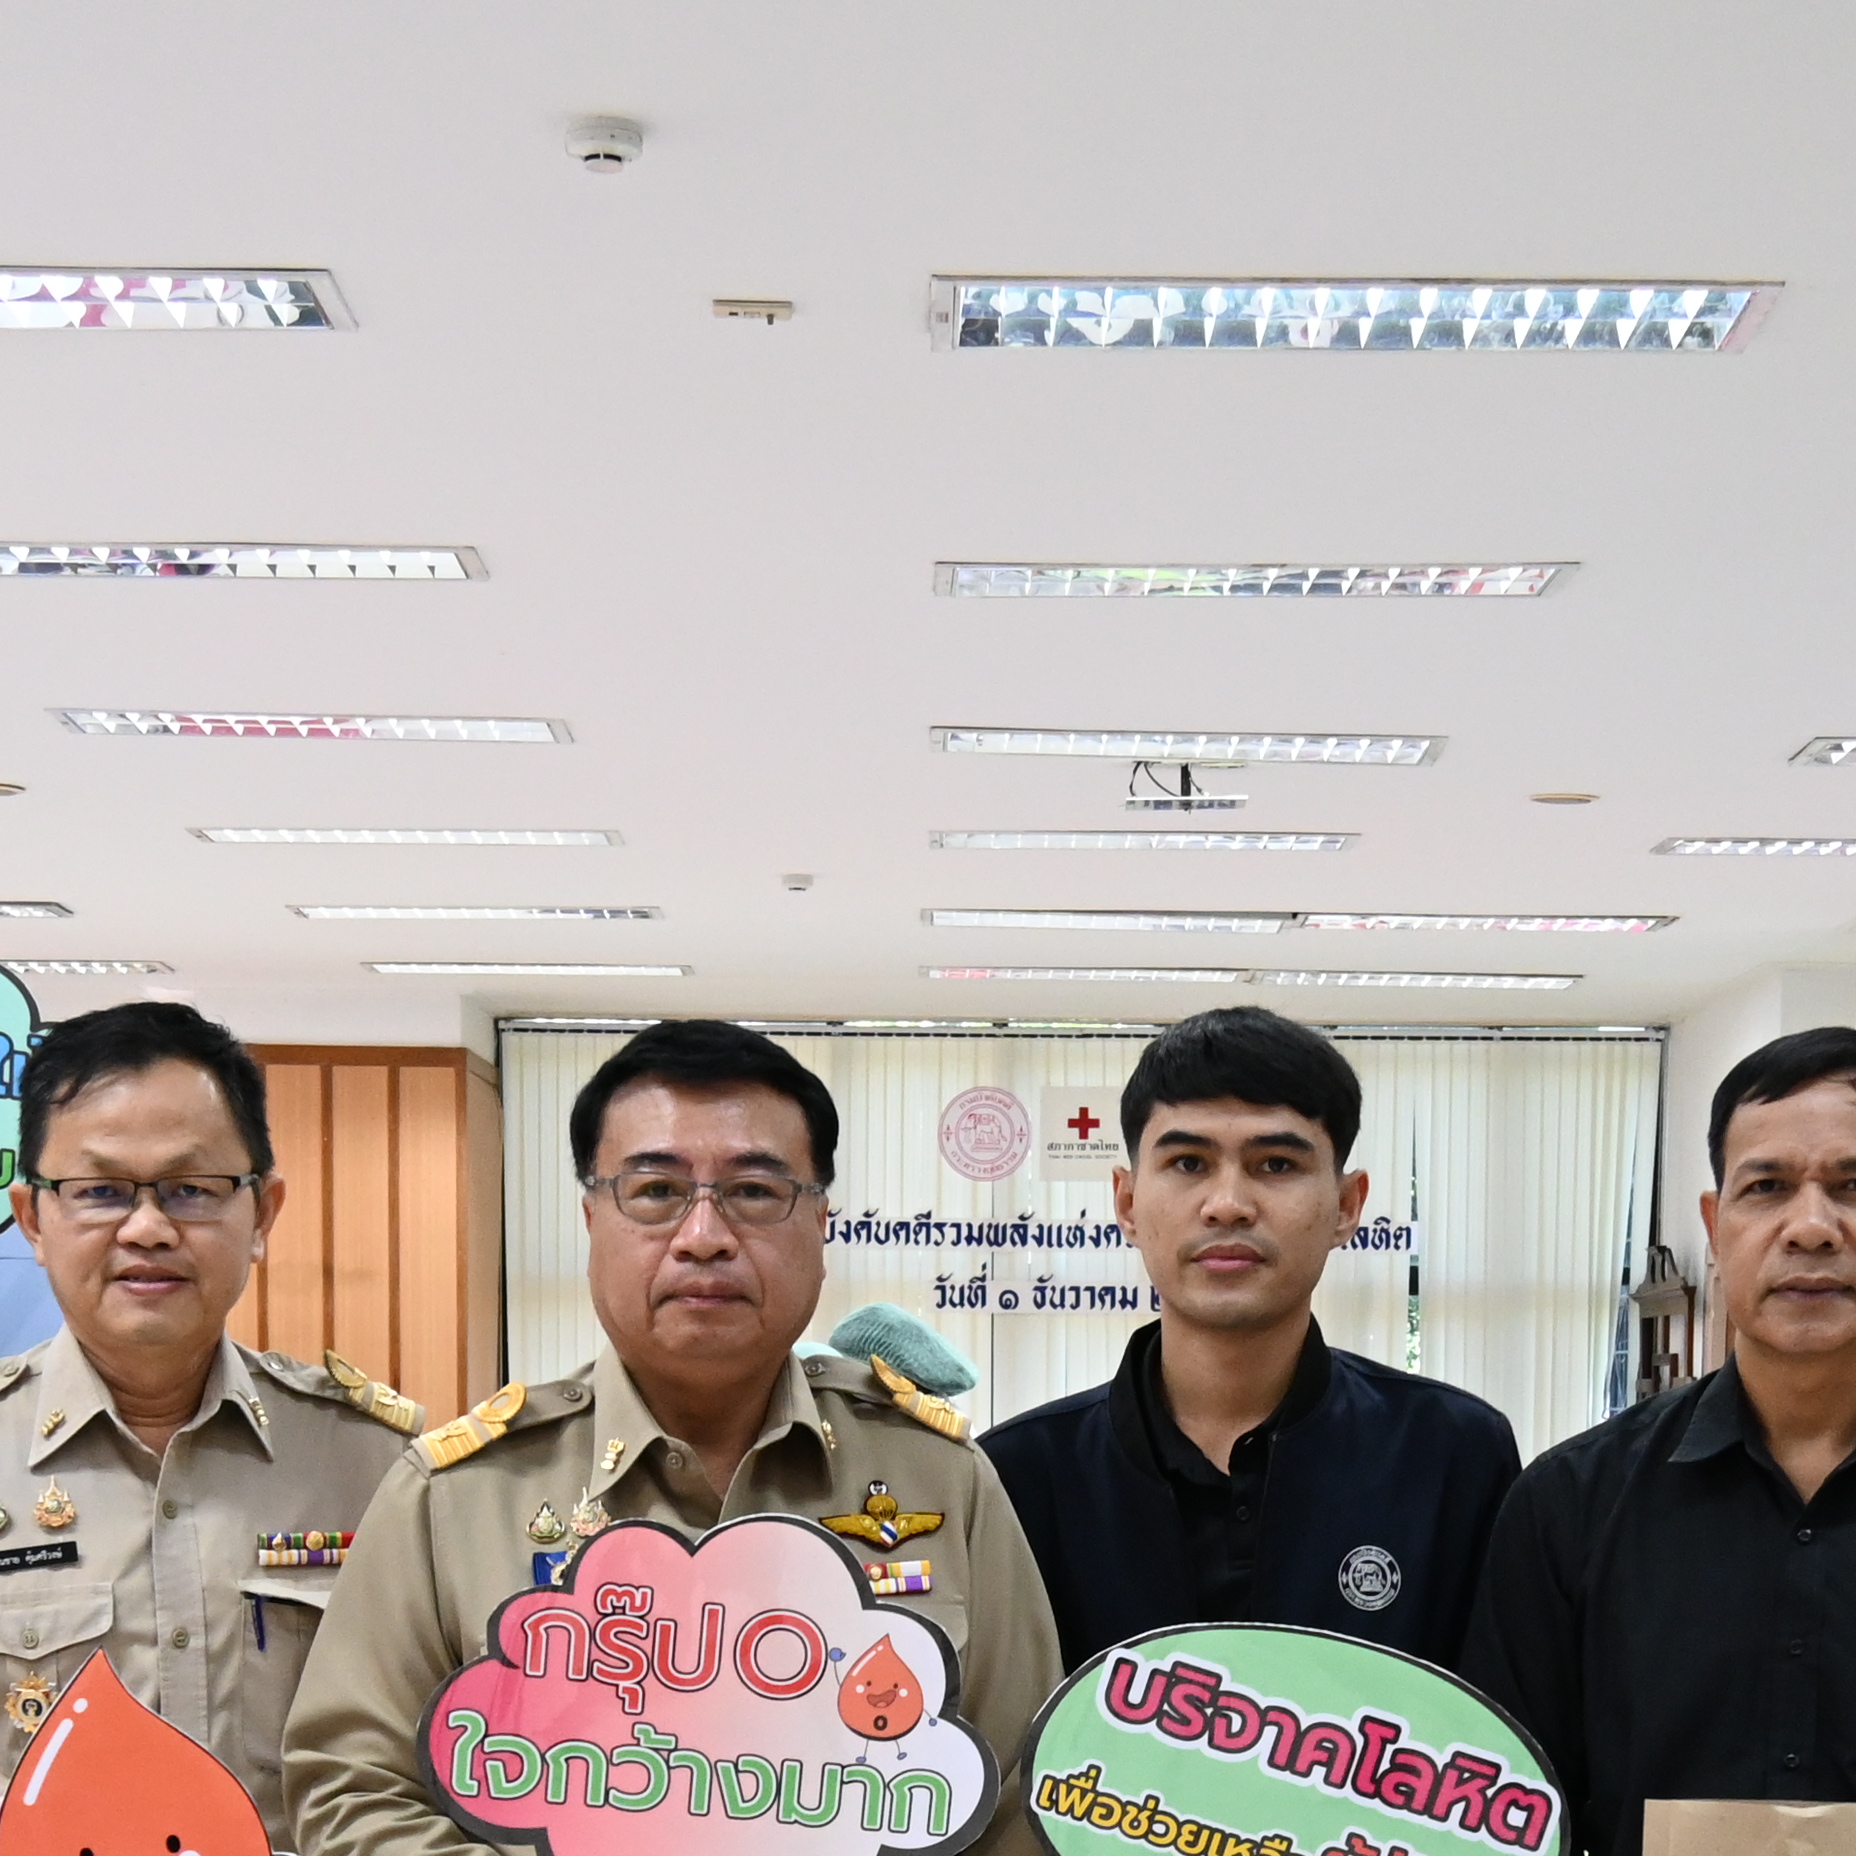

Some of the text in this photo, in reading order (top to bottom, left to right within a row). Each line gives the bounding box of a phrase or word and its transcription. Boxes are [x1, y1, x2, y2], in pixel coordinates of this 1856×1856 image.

[1046, 1139, 1120, 1152] สภากาชาดไทย
[933, 1262, 987, 1310] วันที่
[998, 1288, 1020, 1310] ๑
[1032, 1274, 1139, 1311] ธันวาคม
[446, 1709, 953, 1837] ใจกว้างมาก
[1103, 1655, 1555, 1853] บริจาคโลหิต
